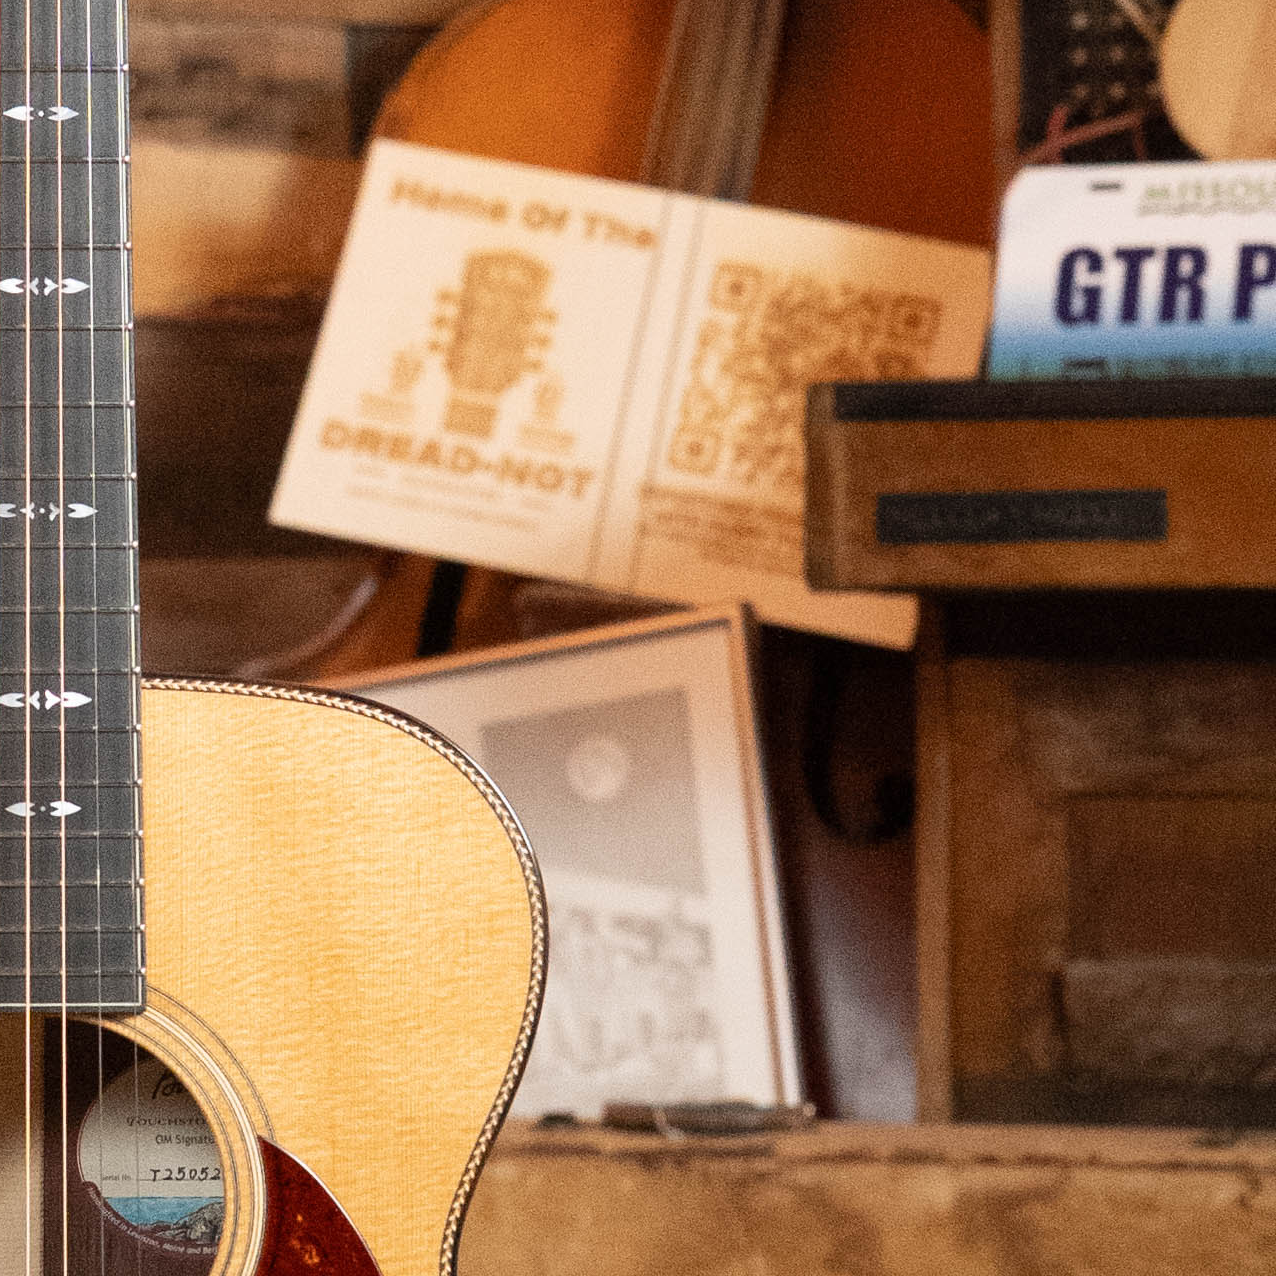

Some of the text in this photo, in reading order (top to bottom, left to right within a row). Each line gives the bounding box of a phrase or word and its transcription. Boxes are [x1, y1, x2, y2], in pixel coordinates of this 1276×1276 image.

[579, 210, 660, 250] The
[1054, 244, 1210, 329] GTR
[317, 418, 595, 501] DREAD-NOT
[155, 1134, 172, 1144] OM
